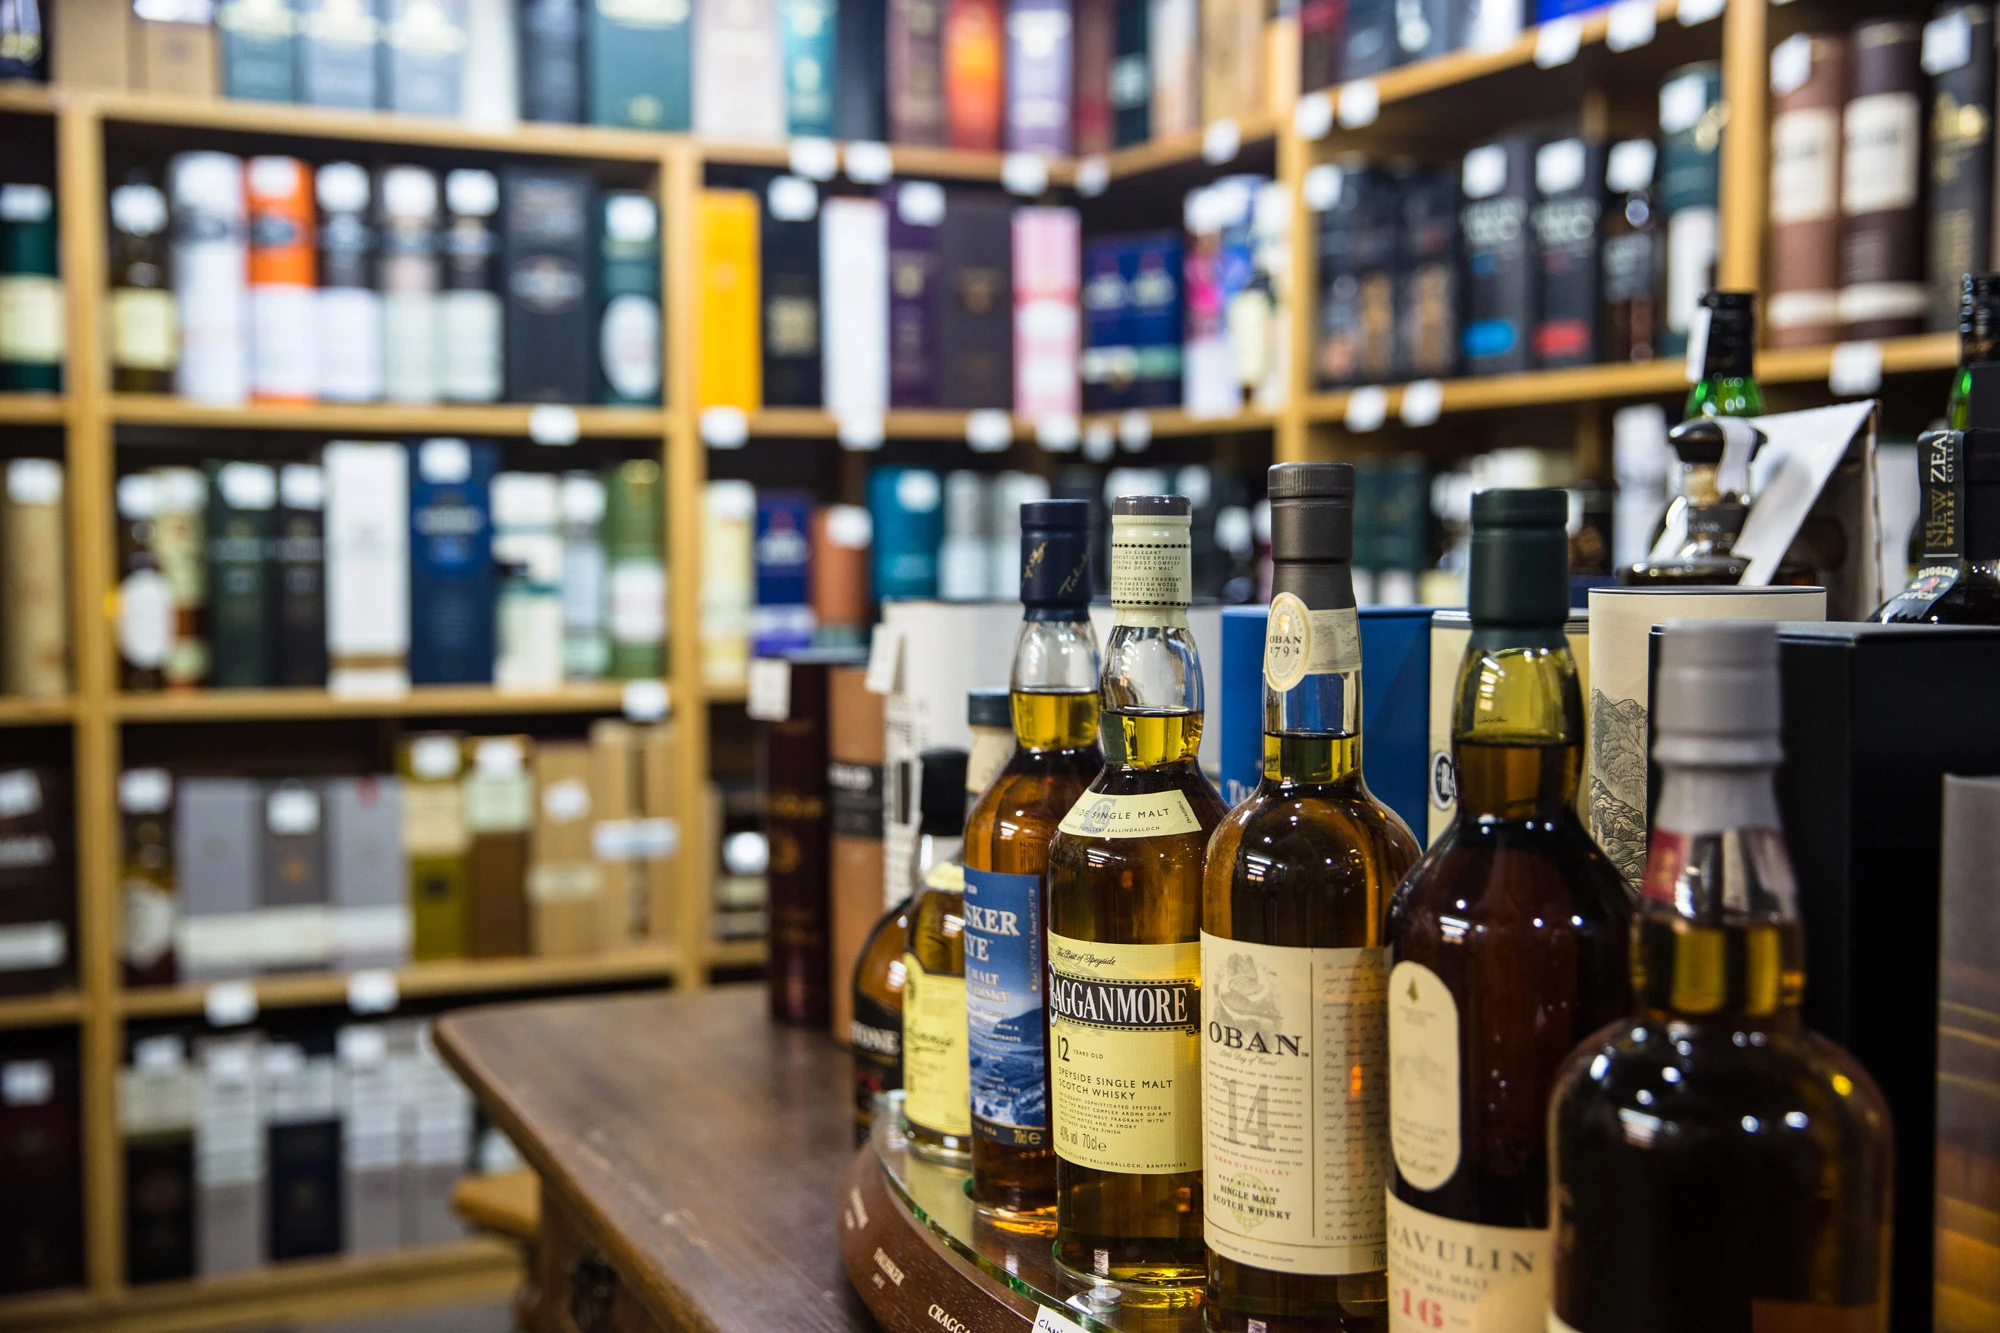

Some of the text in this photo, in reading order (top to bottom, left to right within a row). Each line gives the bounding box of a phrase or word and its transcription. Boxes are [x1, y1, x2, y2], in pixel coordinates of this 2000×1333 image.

[1931, 488, 1947, 548] NEW
[1946, 491, 1955, 547] WHISKY
[1270, 636, 1302, 644] OBAN
[1270, 646, 1300, 658] 1794
[1091, 810, 1131, 820] SINGLE
[1138, 808, 1170, 819] MALT
[1064, 950, 1077, 960] Best
[1076, 954, 1086, 964] of
[1084, 954, 1116, 968] Speyside
[971, 968, 999, 986] MALT
[1058, 1035, 1070, 1062] 12
[1209, 1020, 1302, 1056] OBAN
[1058, 1066, 1173, 1089] SPEYSIDE SINGLE MALT
[1059, 1078, 1136, 1101] SCOTCH WHISKY
[1084, 1100, 1129, 1109] SOPHISTICATED
[1090, 1158, 1144, 1169] BALLINDALLOCH,
[1220, 1184, 1277, 1205] SINGLE MALT
[1237, 1180, 1280, 1193] HIGHLAND
[1213, 1193, 1291, 1220] SCOTCH WHISKY
[1404, 1256, 1442, 1280] SINGLE
[1450, 1272, 1489, 1289] MALT
[1426, 1283, 1478, 1302] WHISKY
[1402, 1288, 1444, 1329] 16
